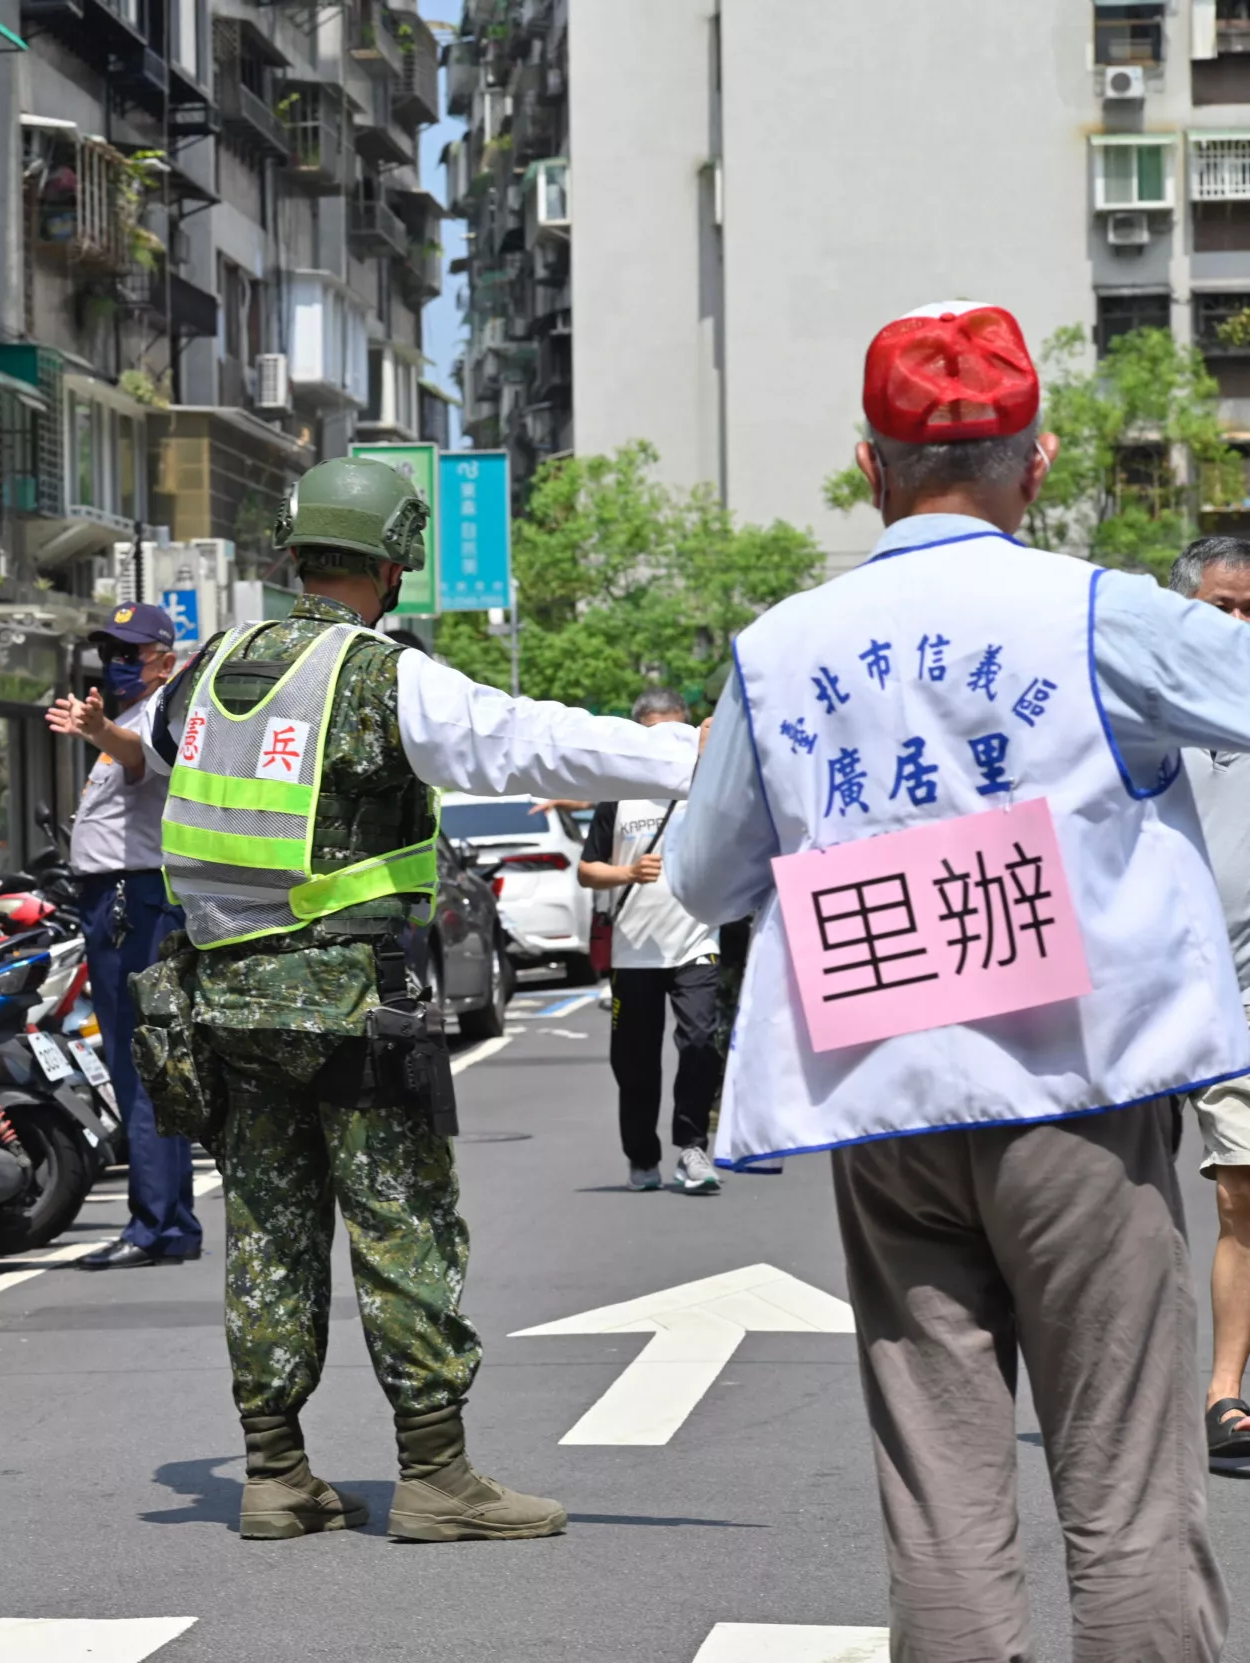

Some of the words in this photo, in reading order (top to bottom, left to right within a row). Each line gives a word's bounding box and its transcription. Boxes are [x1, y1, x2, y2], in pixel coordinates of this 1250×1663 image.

[780, 633, 1058, 755] 臺北市信義區
[824, 732, 1014, 818] 廣居里
[811, 841, 1055, 1002] 里辦
